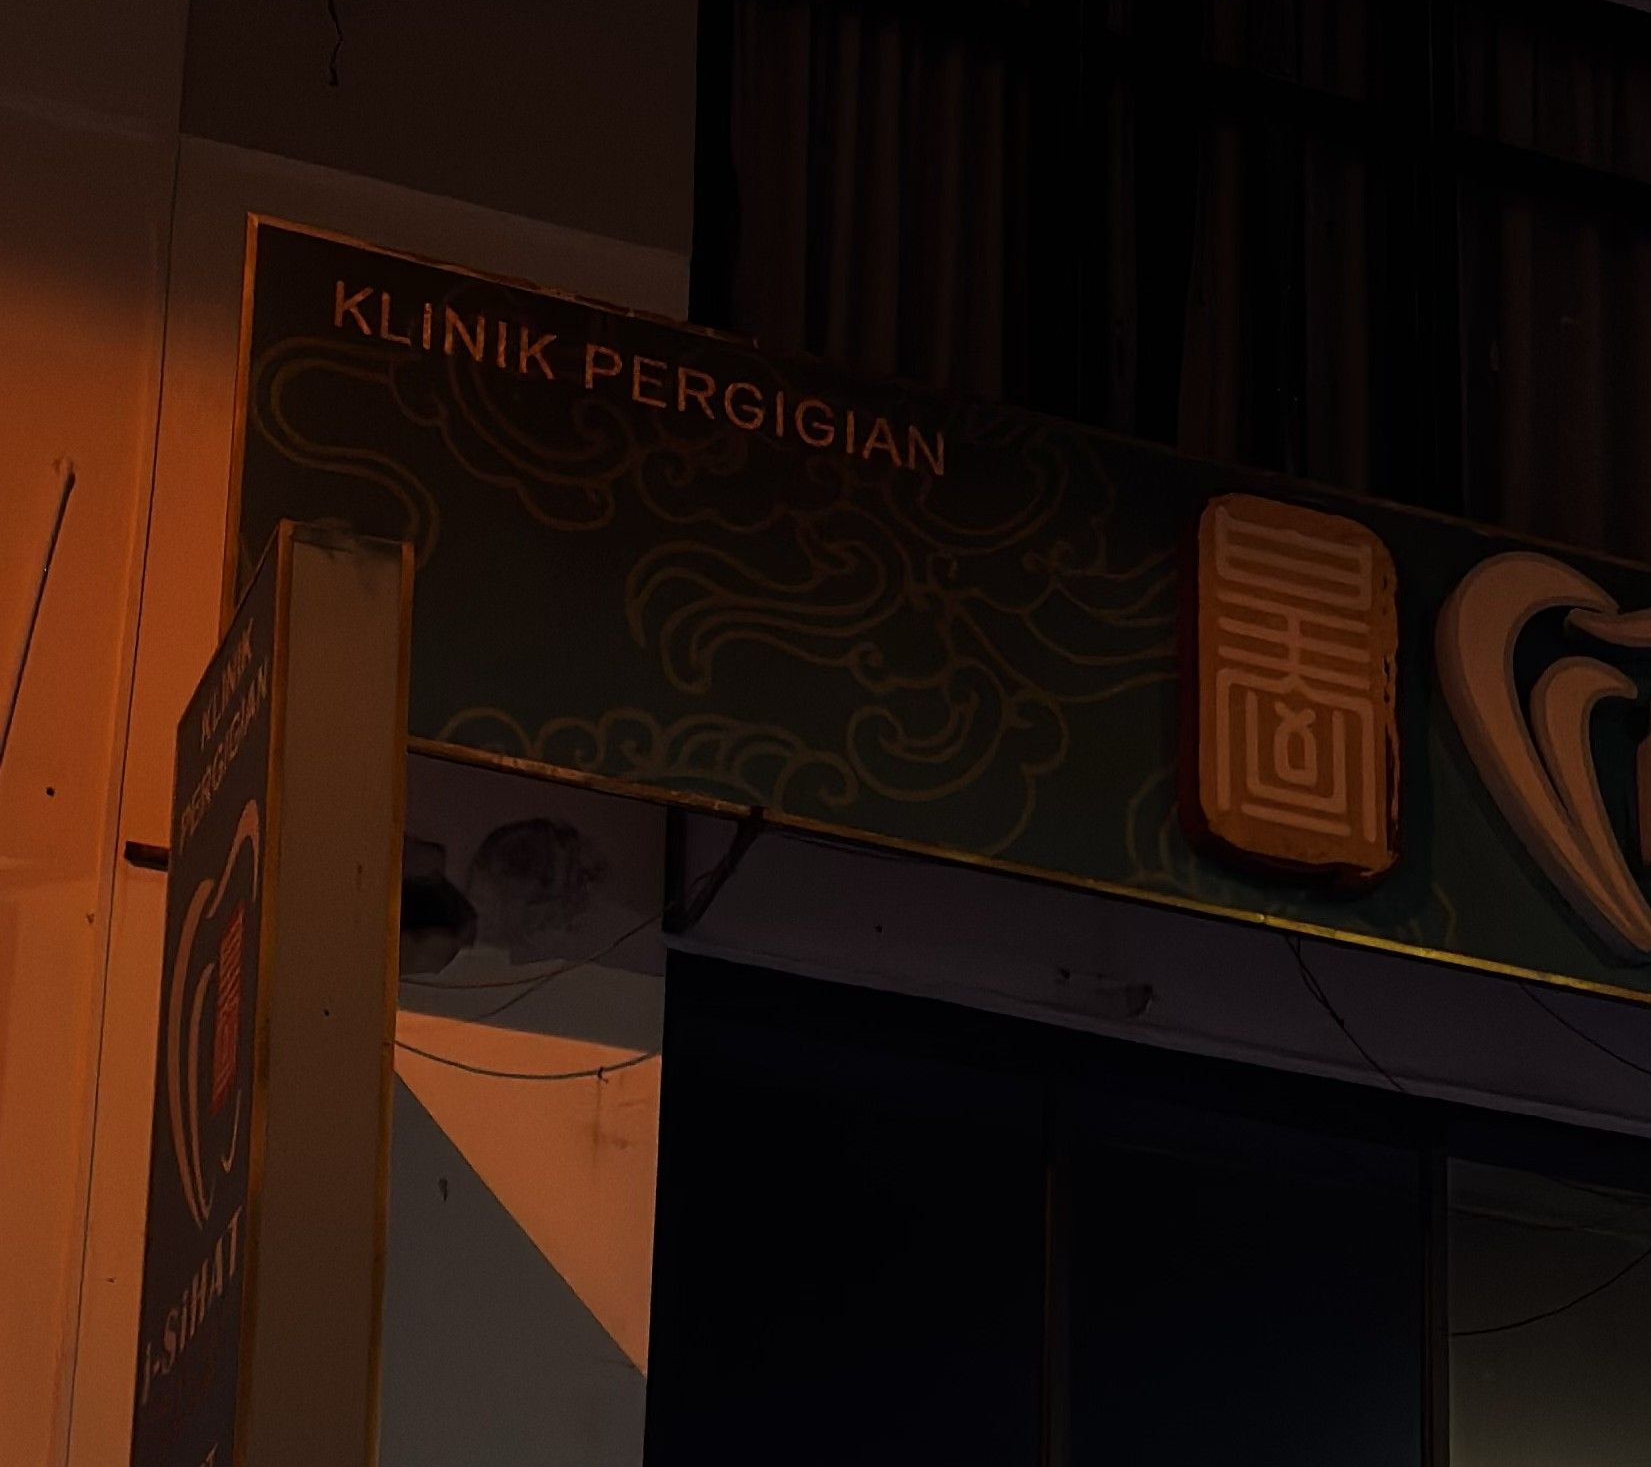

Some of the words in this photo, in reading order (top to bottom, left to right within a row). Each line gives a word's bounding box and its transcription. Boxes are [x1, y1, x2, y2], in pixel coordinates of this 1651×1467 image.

[333, 280, 558, 381] KLINIK
[584, 343, 946, 477] PERGIGIAN
[201, 615, 254, 751] KLINIK
